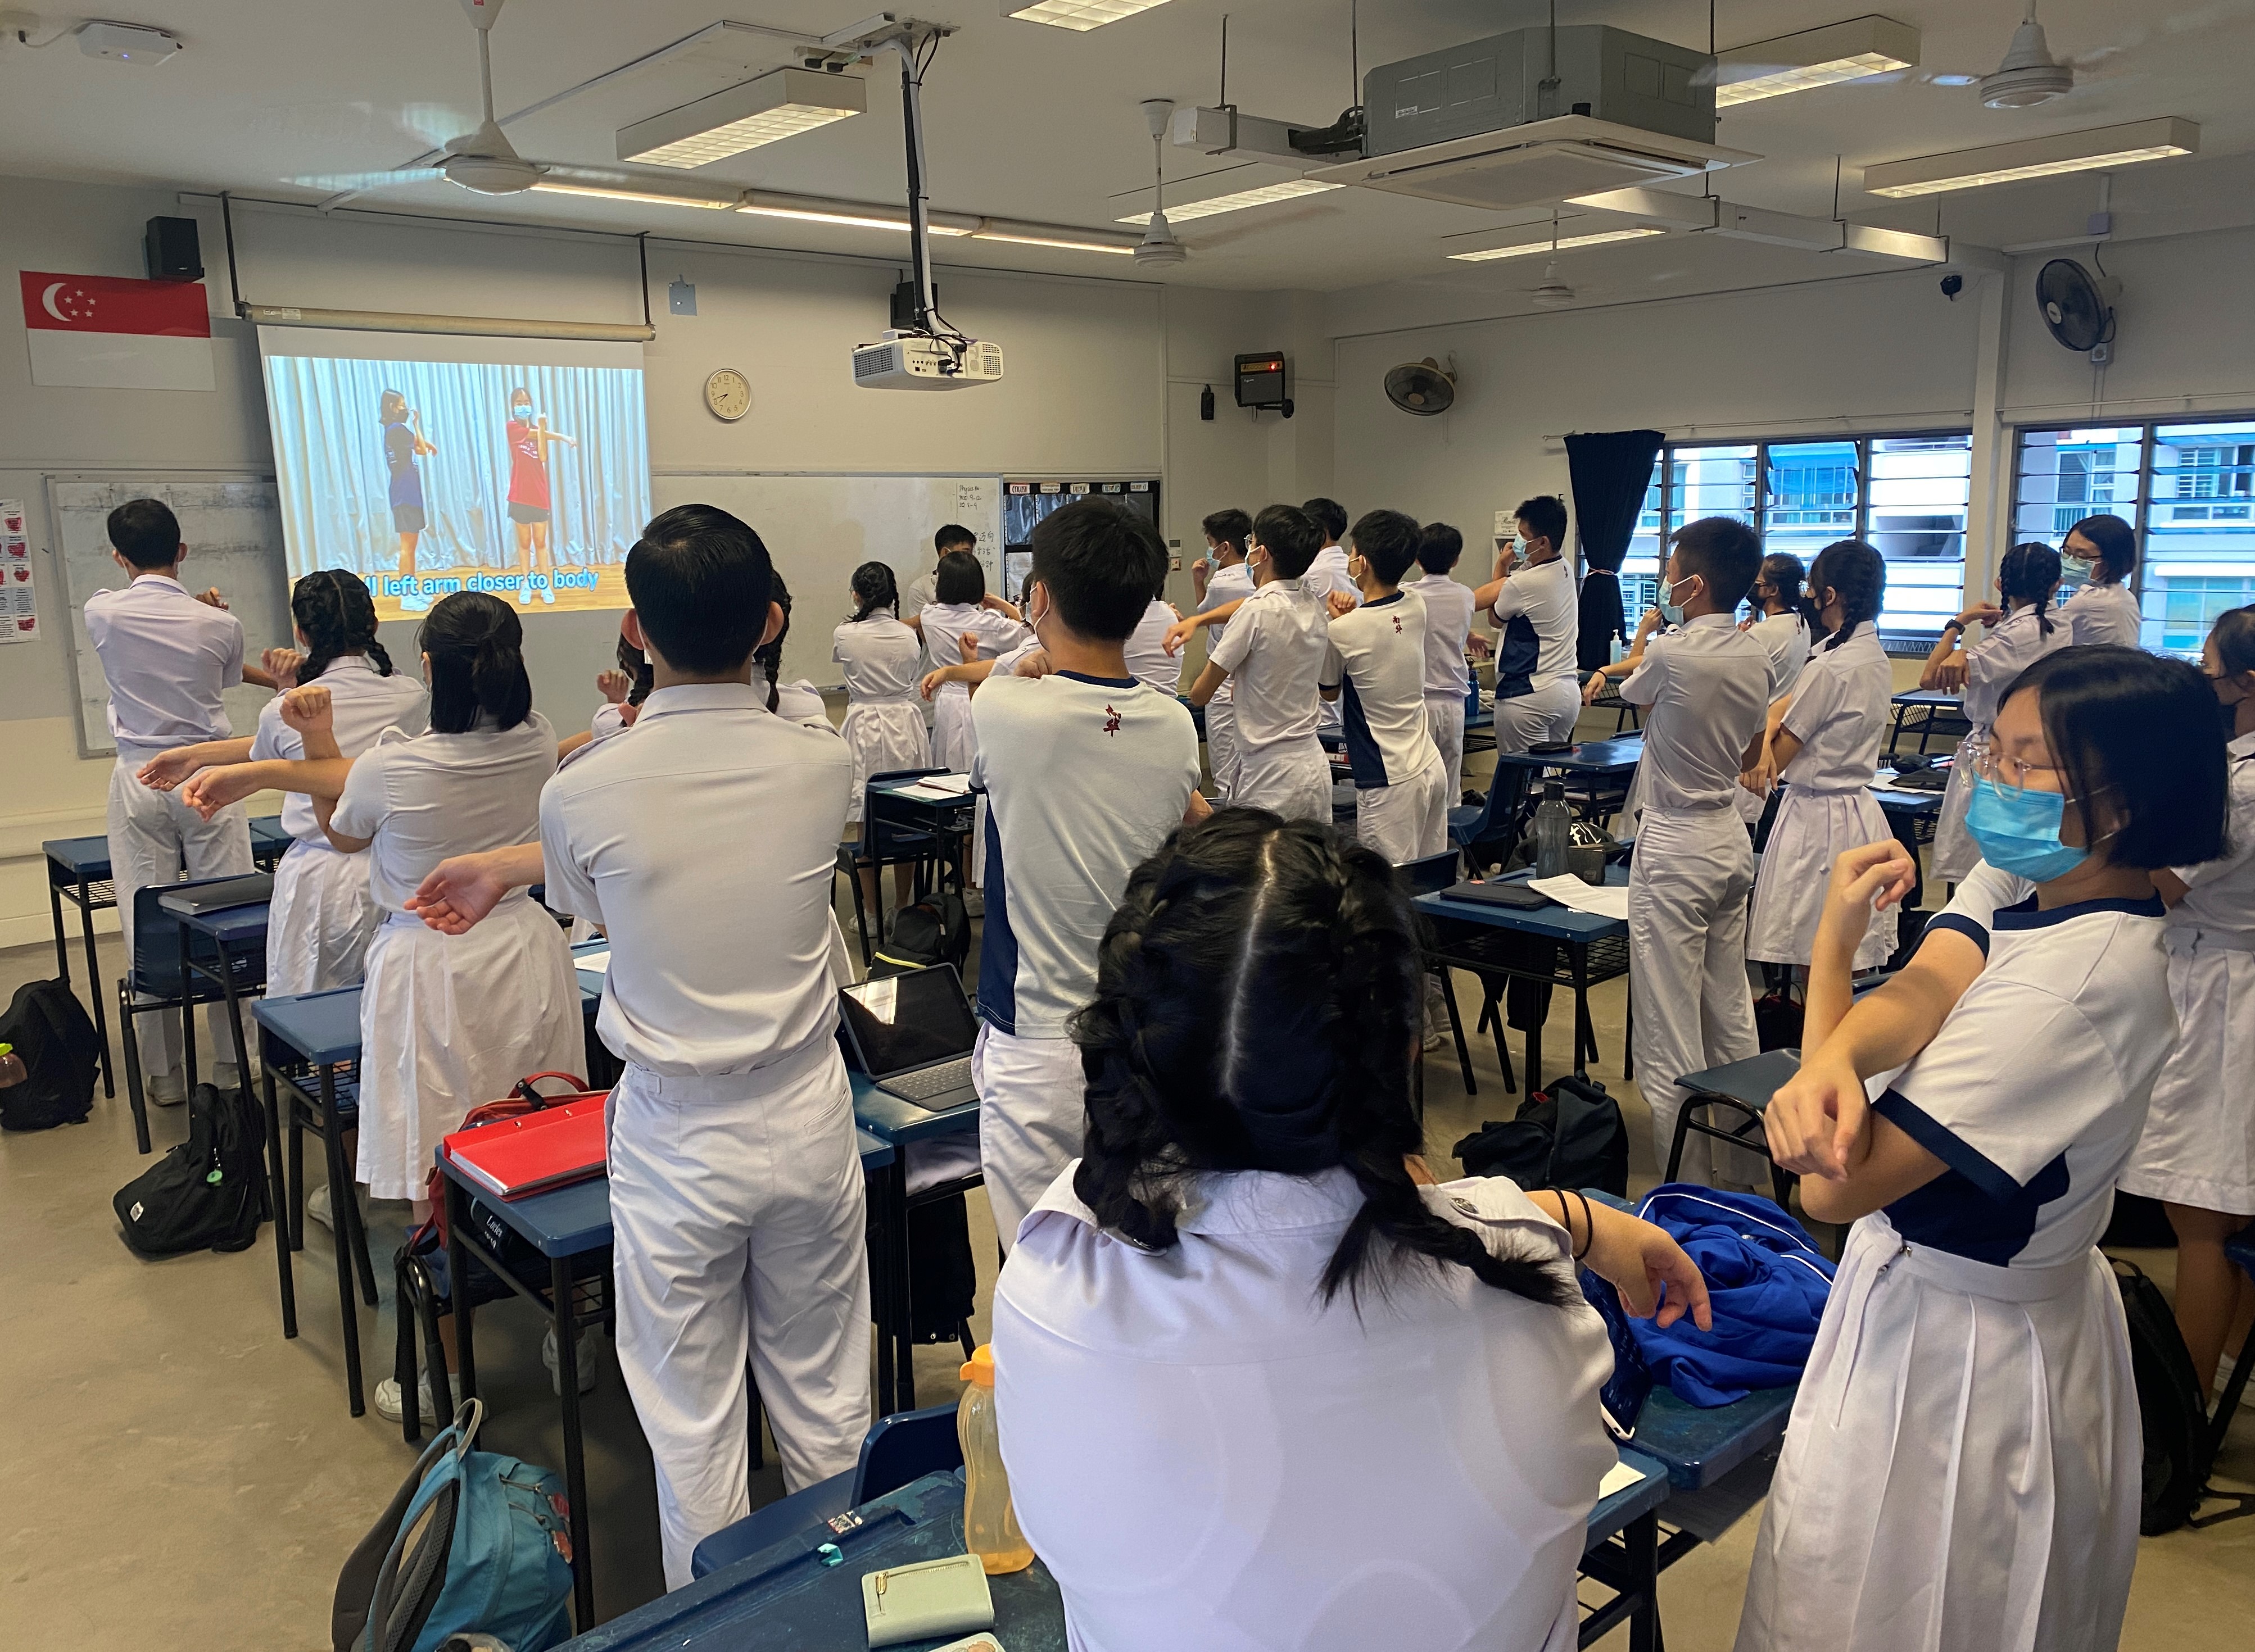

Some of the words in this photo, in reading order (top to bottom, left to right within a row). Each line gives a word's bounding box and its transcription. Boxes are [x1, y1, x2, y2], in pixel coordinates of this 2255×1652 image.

[383, 574, 418, 596] left
[422, 577, 461, 595] arm
[466, 571, 524, 592] closer
[528, 570, 548, 589] to
[553, 566, 599, 592] body
